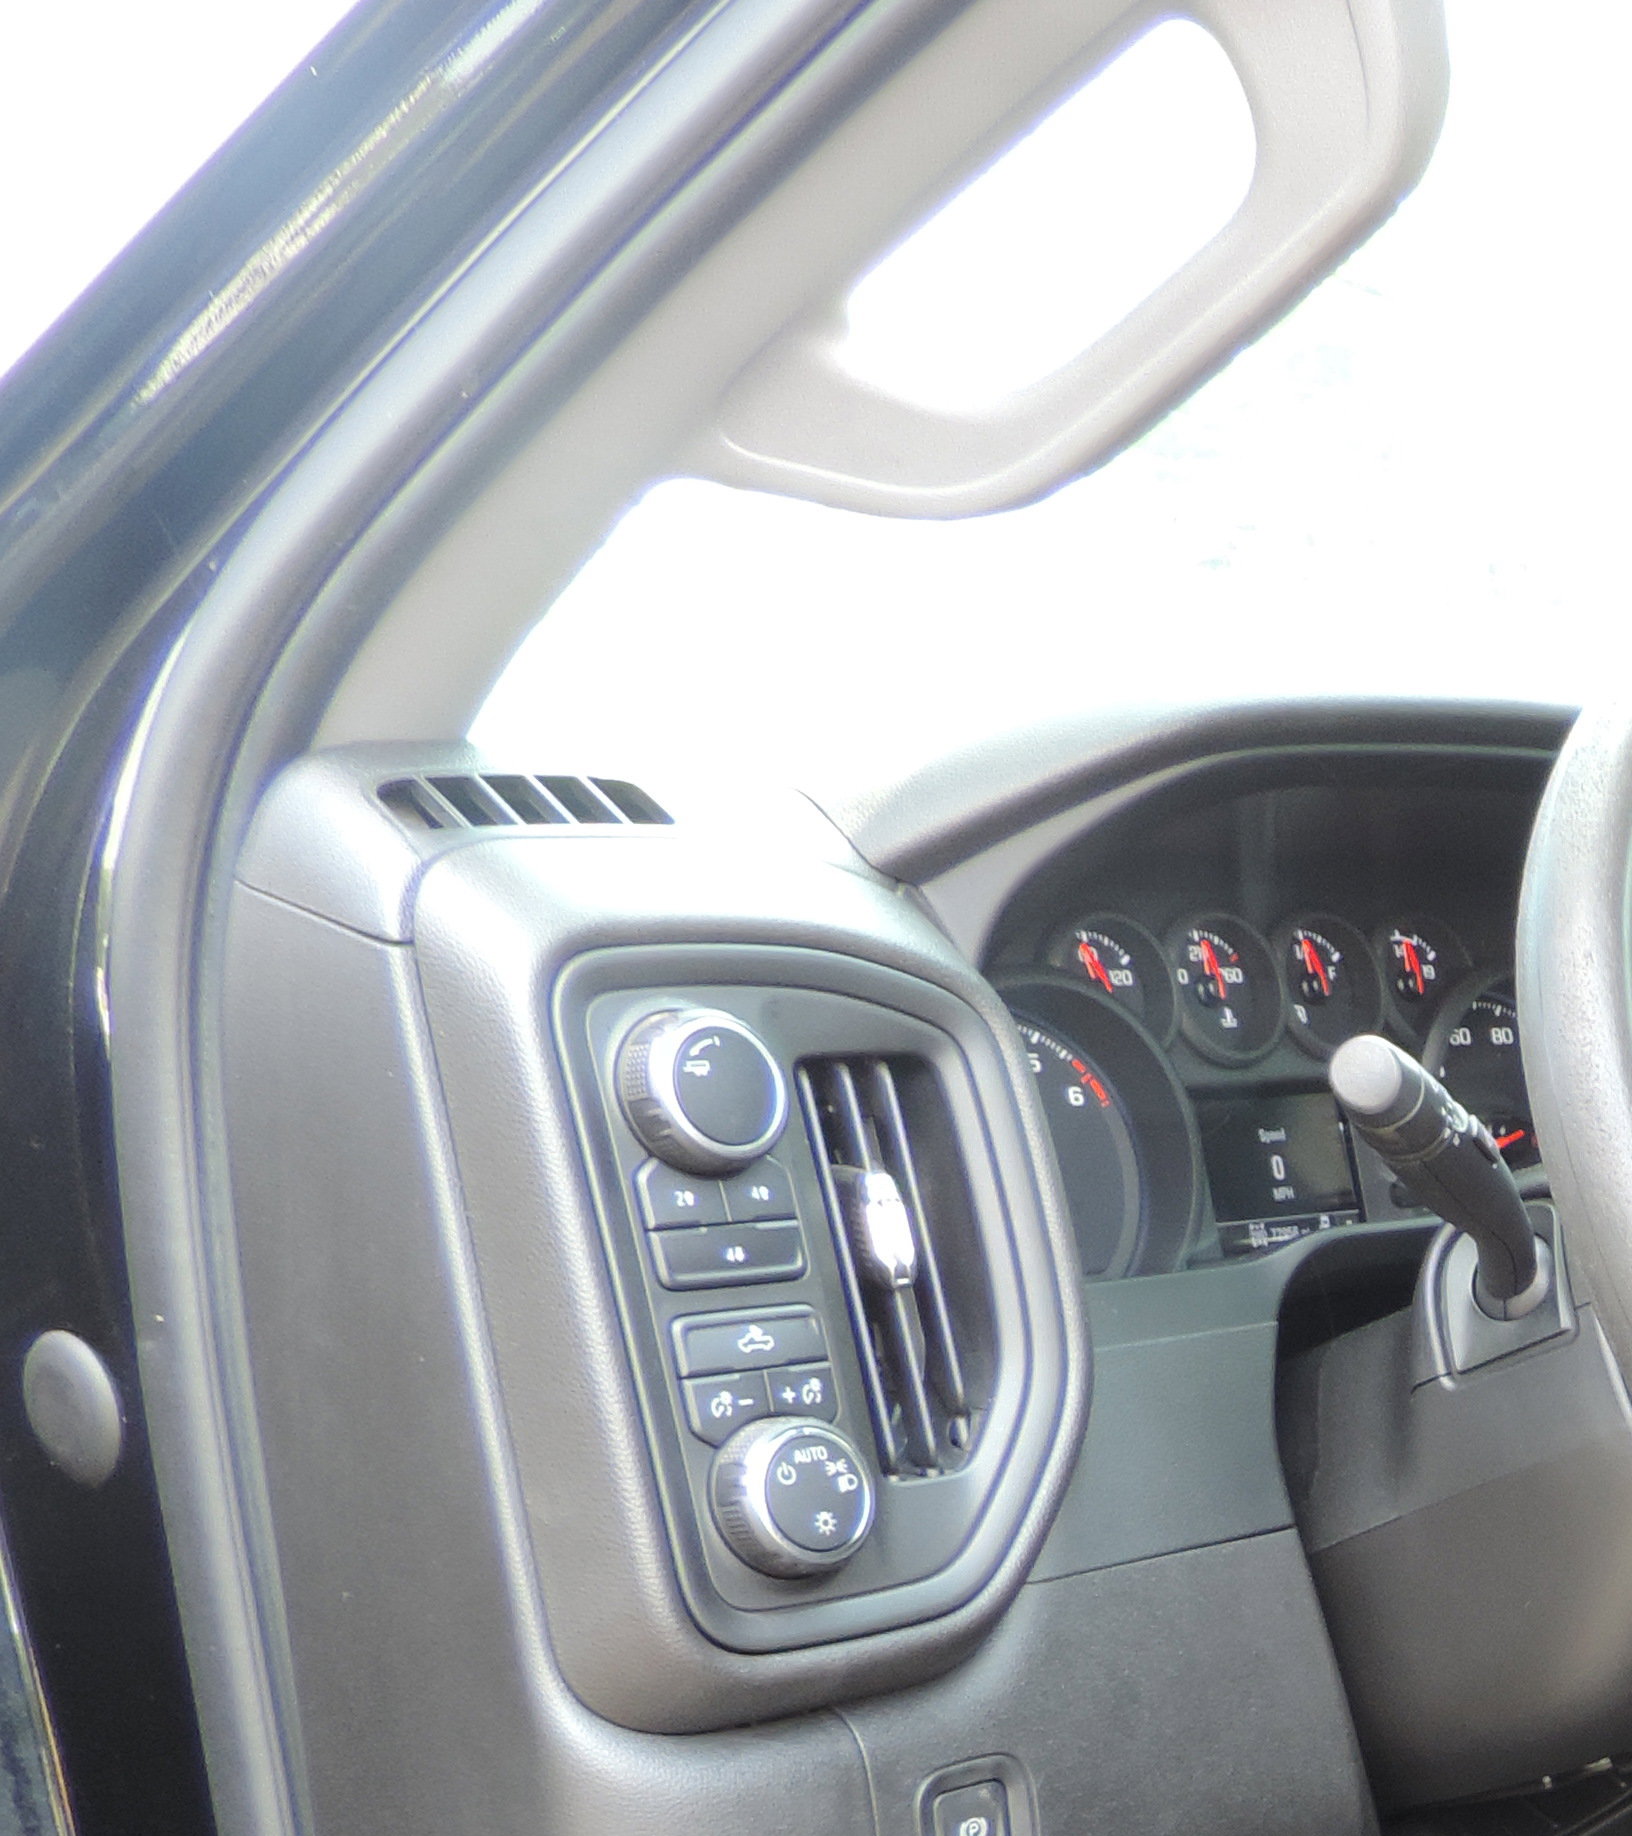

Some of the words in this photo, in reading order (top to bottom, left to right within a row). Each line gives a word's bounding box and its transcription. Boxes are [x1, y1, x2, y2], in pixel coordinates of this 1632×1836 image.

[1490, 1026, 1514, 1045] 80
[1066, 1086, 1085, 1107] 6
[1270, 1154, 1286, 1181] 0
[793, 1444, 829, 1464] AUTO
